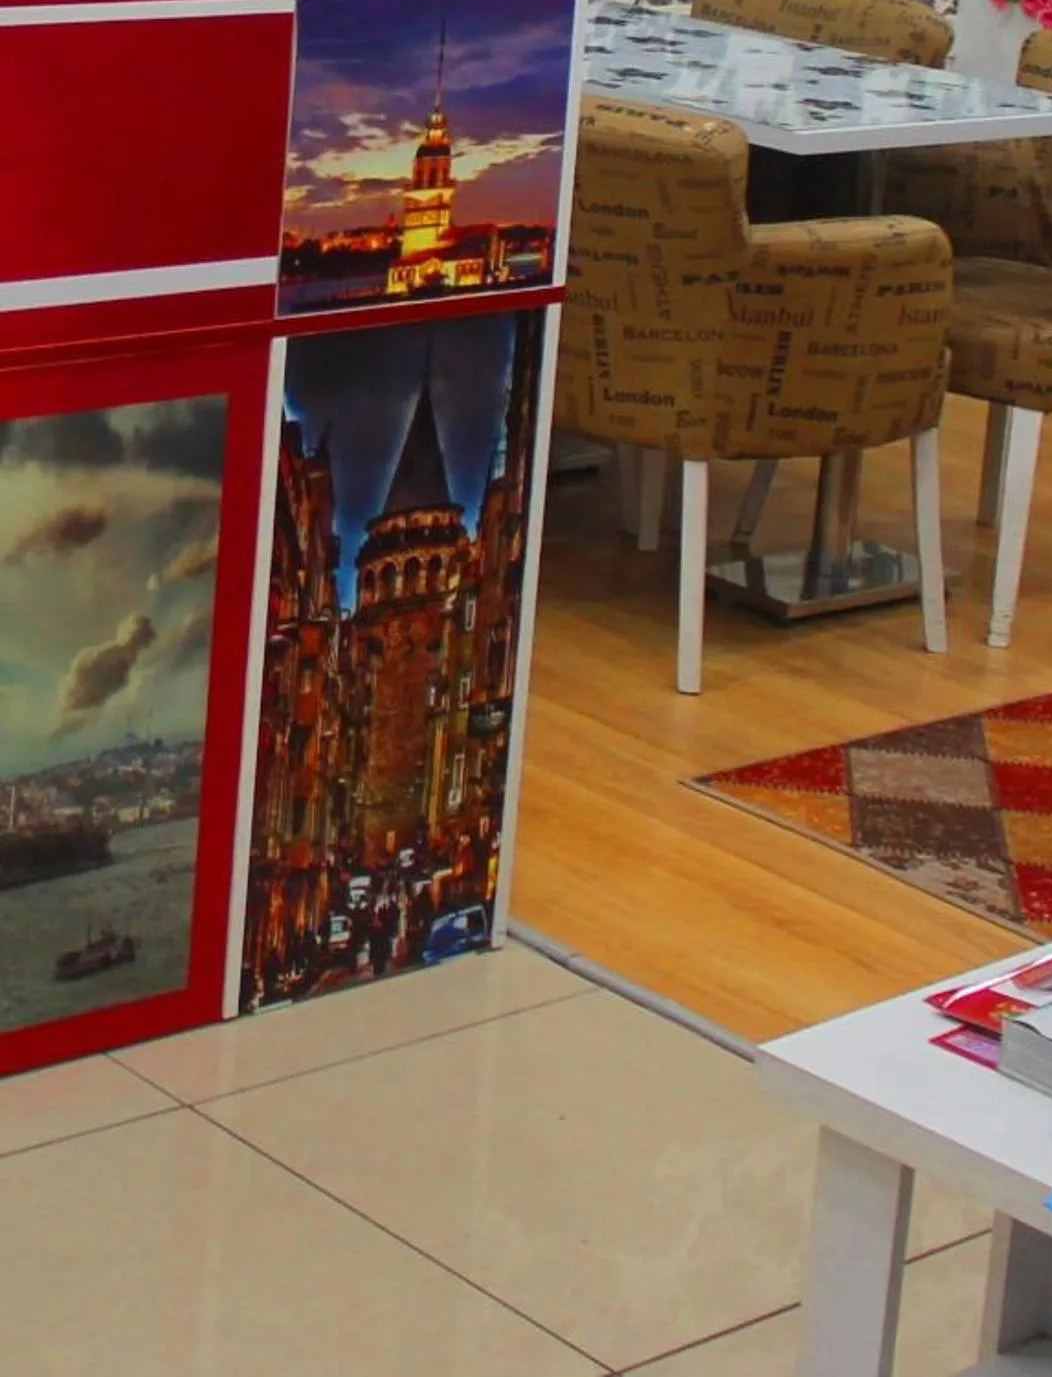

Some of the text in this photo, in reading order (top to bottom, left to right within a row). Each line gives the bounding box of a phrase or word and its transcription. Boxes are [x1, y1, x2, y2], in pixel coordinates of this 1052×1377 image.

[876, 280, 947, 298] PARIS
[603, 387, 676, 408] London
[768, 401, 839, 423] London
